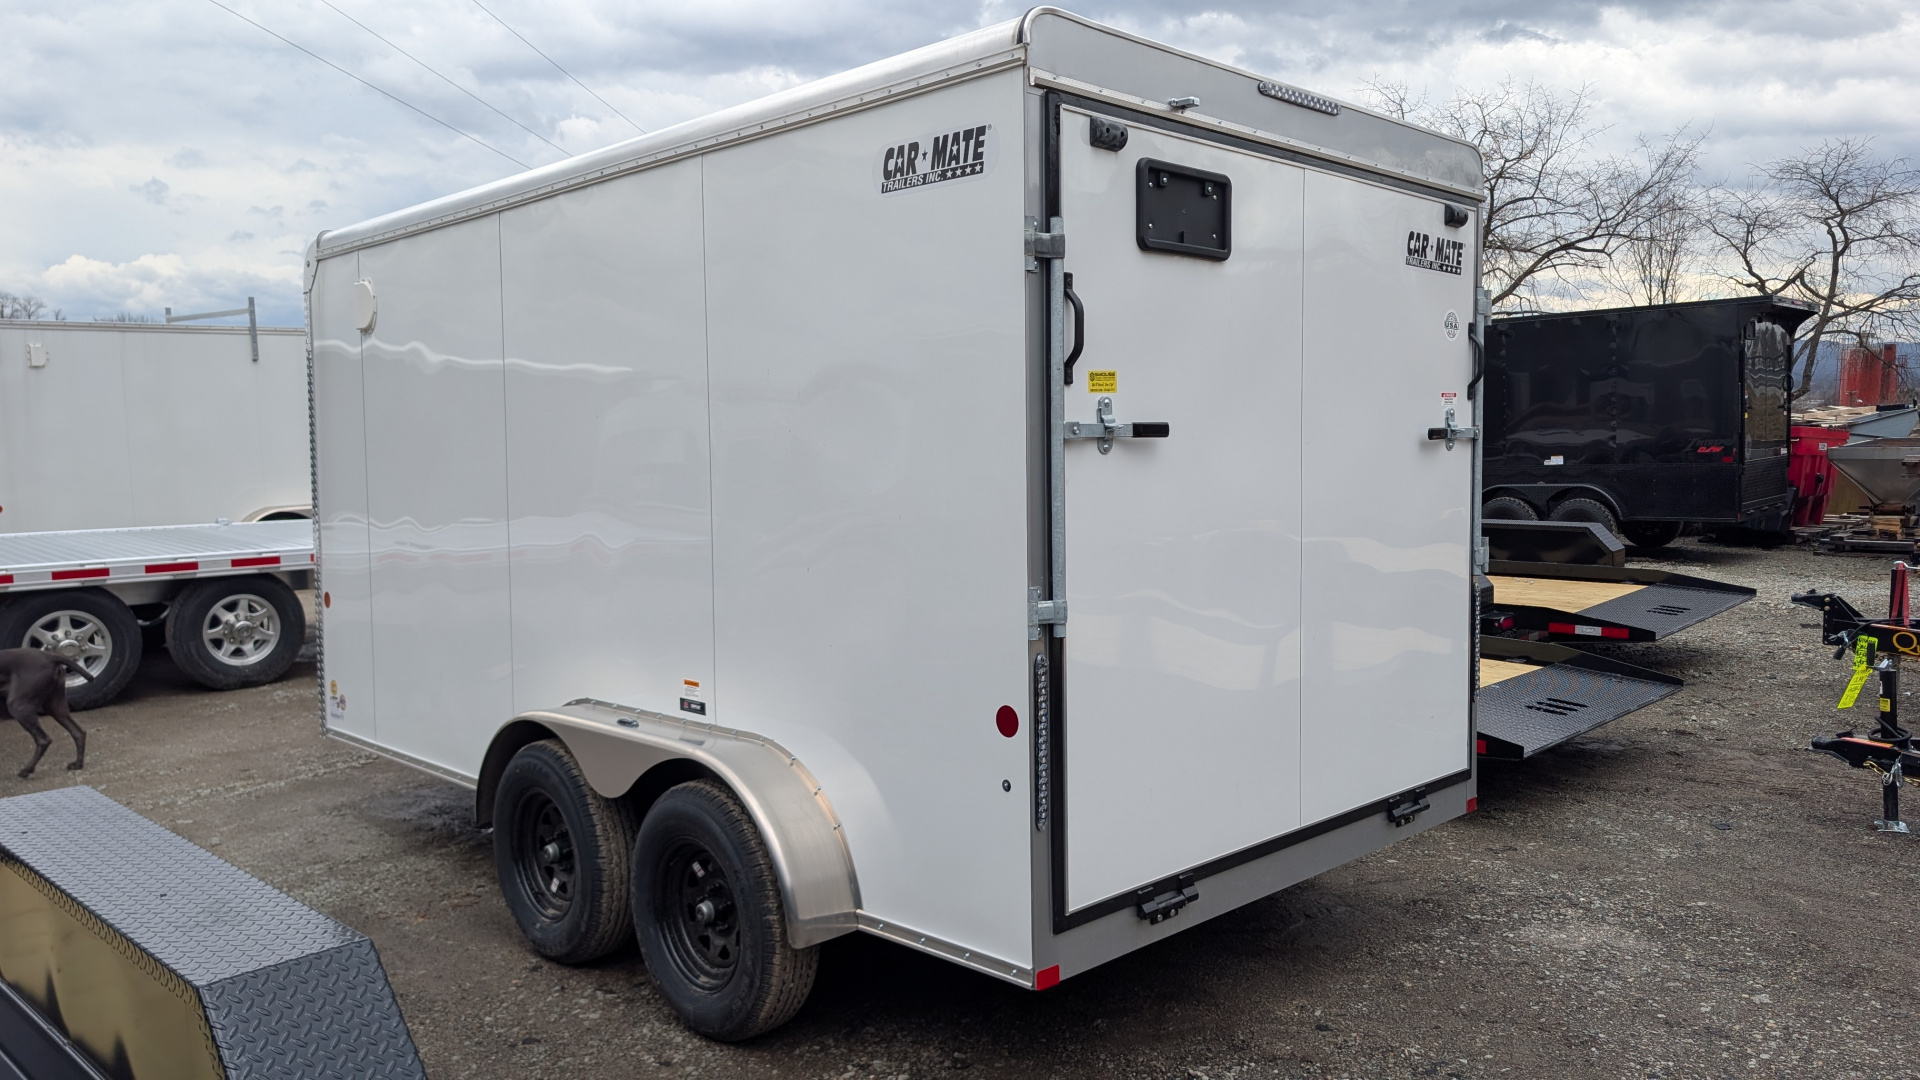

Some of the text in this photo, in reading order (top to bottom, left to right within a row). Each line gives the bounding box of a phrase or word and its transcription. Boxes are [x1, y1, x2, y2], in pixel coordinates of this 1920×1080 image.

[883, 125, 987, 181] CAR MATE
[882, 171, 944, 193] TRAILERS INC.
[1407, 231, 1464, 266] CAR MATE
[1406, 256, 1442, 271] TRAILERS INC.
[1444, 321, 1458, 329] USA
